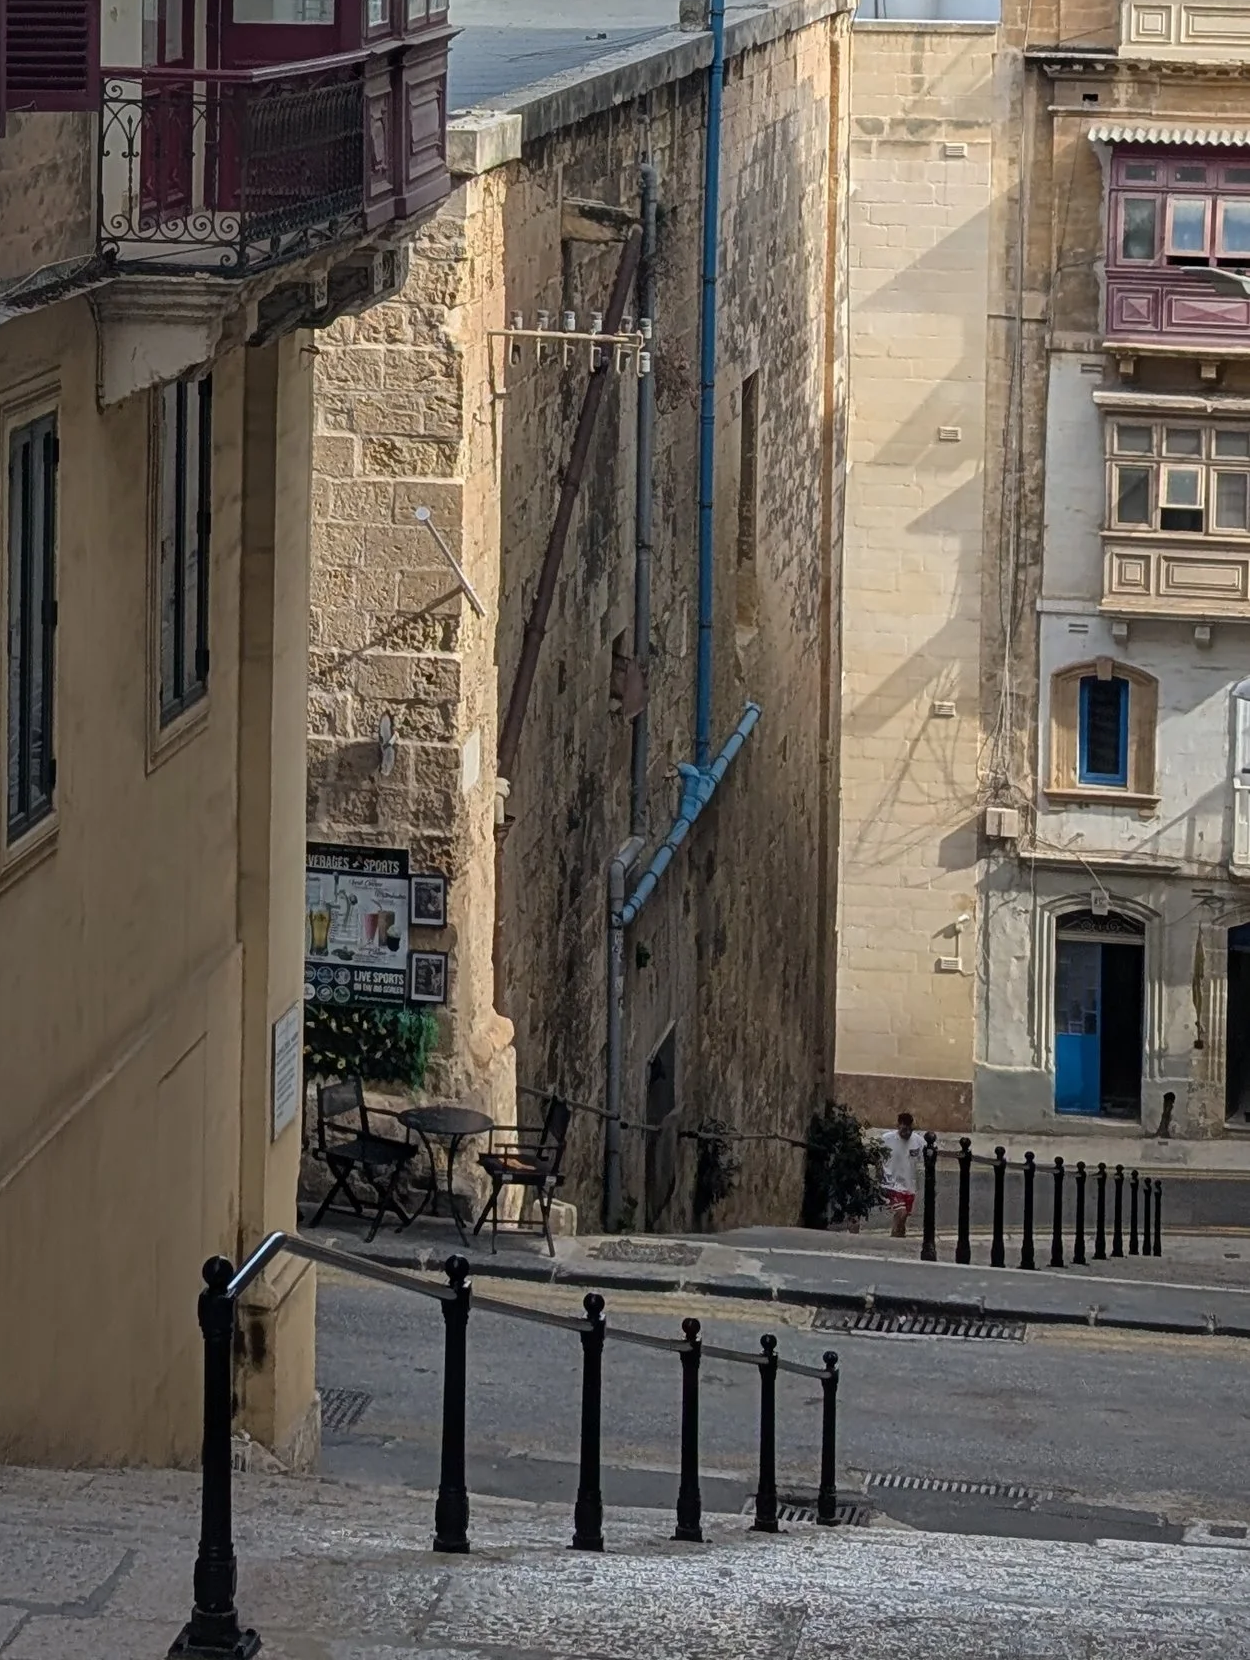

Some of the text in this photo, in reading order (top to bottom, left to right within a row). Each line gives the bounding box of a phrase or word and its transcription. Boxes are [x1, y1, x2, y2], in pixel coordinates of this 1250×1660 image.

[363, 858, 400, 874] SPORTS
[354, 970, 404, 985] LIVE SPORTS
